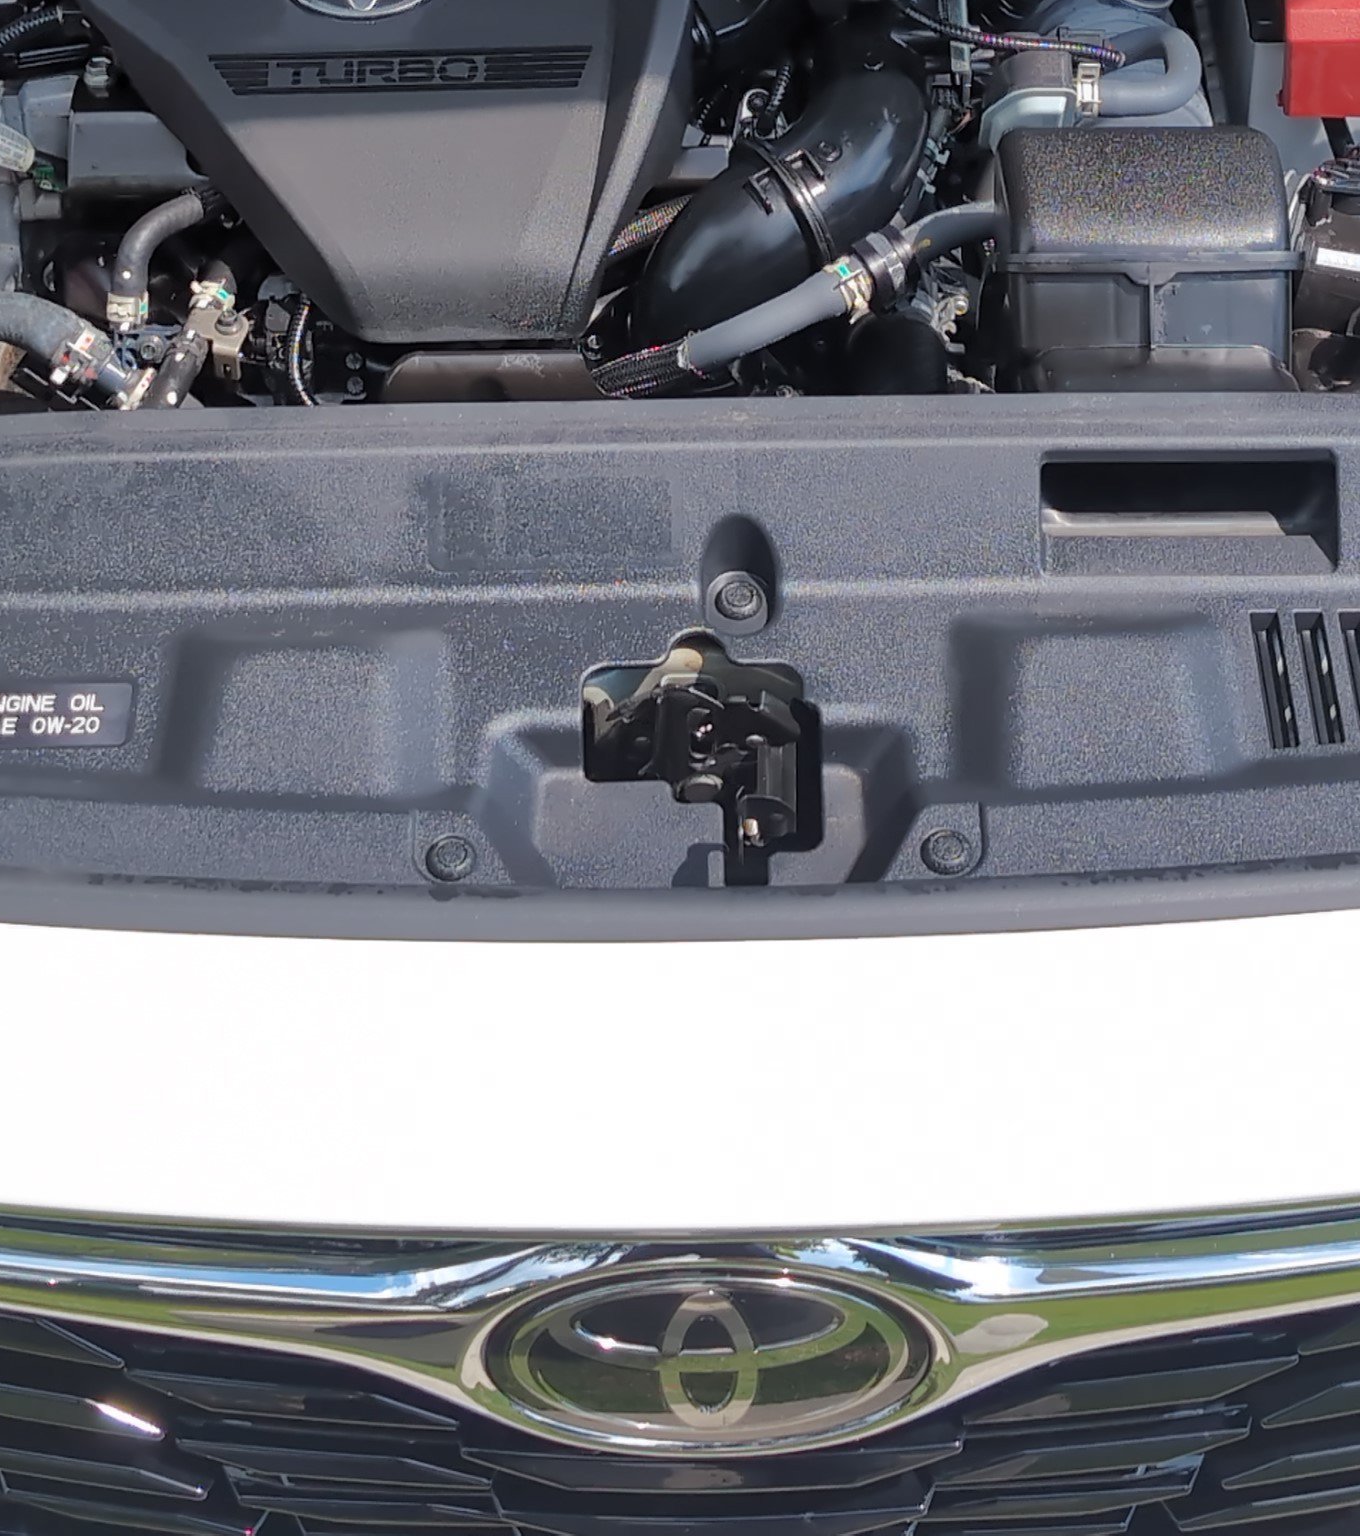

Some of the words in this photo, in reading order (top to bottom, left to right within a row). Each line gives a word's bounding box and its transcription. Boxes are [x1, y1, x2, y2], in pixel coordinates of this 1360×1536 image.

[276, 57, 479, 86] TURBO
[70, 693, 104, 712] OIL
[31, 715, 101, 735] 0W-20
